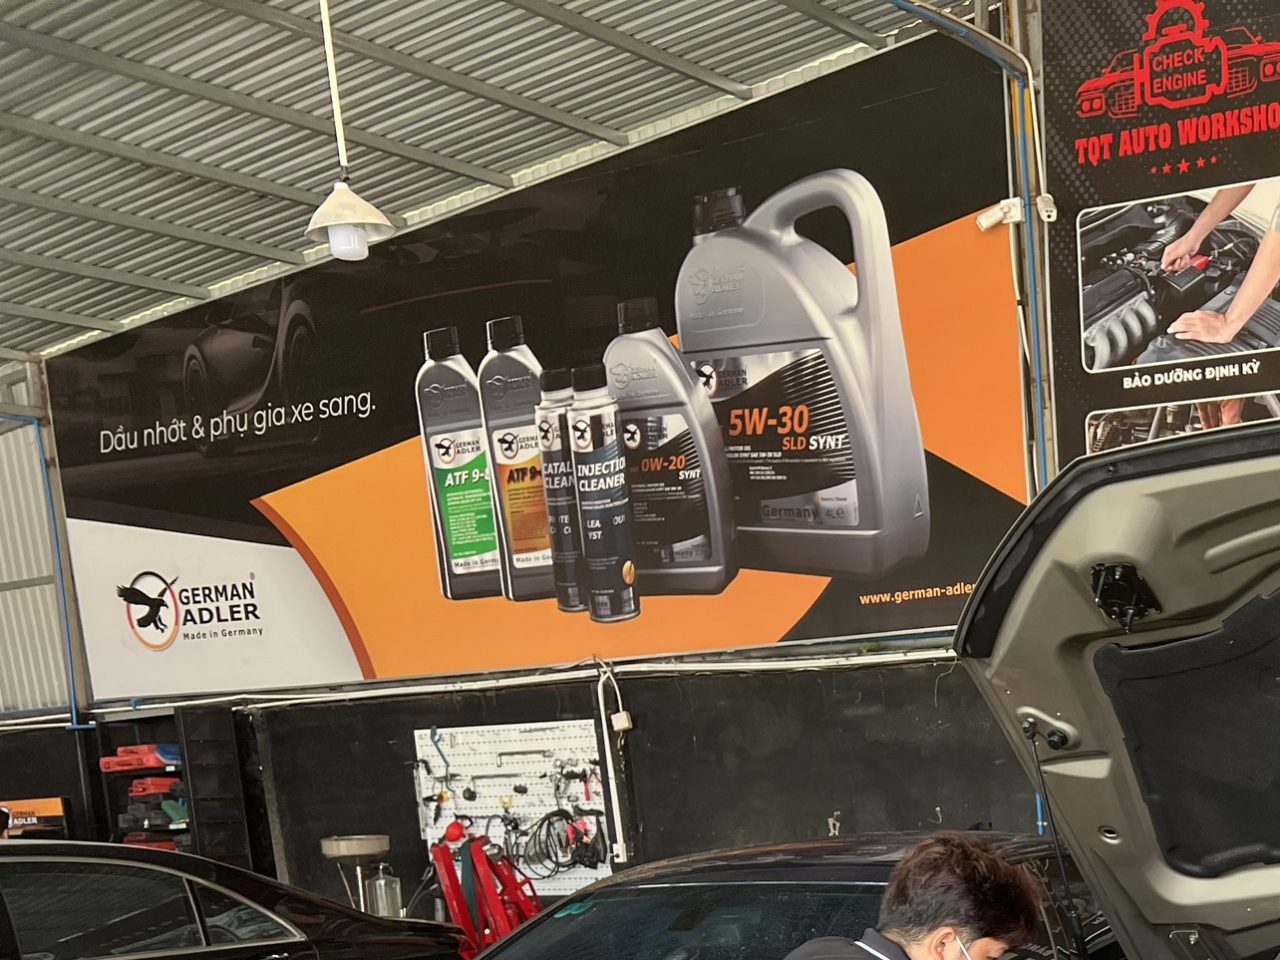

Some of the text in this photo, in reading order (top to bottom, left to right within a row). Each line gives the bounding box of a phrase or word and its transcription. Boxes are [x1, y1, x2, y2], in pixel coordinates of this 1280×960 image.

[1152, 47, 1205, 72] CHECK
[1153, 69, 1207, 94] ENGINE
[1075, 133, 1113, 167] TQT
[1119, 123, 1172, 157] AUTO
[1123, 372, 1152, 389] BẢO
[1154, 366, 1201, 385] DƯỠNG
[1204, 363, 1239, 382] ĐỊNH
[100, 391, 377, 453] Dầu nhớt & phụ gia xe sang.
[729, 404, 809, 437] 5W-30
[456, 446, 481, 455] ADLER
[782, 434, 846, 451] SLD SYNT
[641, 455, 686, 471] 0W-20
[445, 471, 469, 487] ATF
[579, 473, 625, 491] CLEANER
[679, 470, 701, 480] SYNT
[762, 504, 819, 519] Germany
[178, 582, 255, 606] GERMAN
[182, 603, 261, 626] ADLER
[183, 628, 263, 640] Made in Germany
